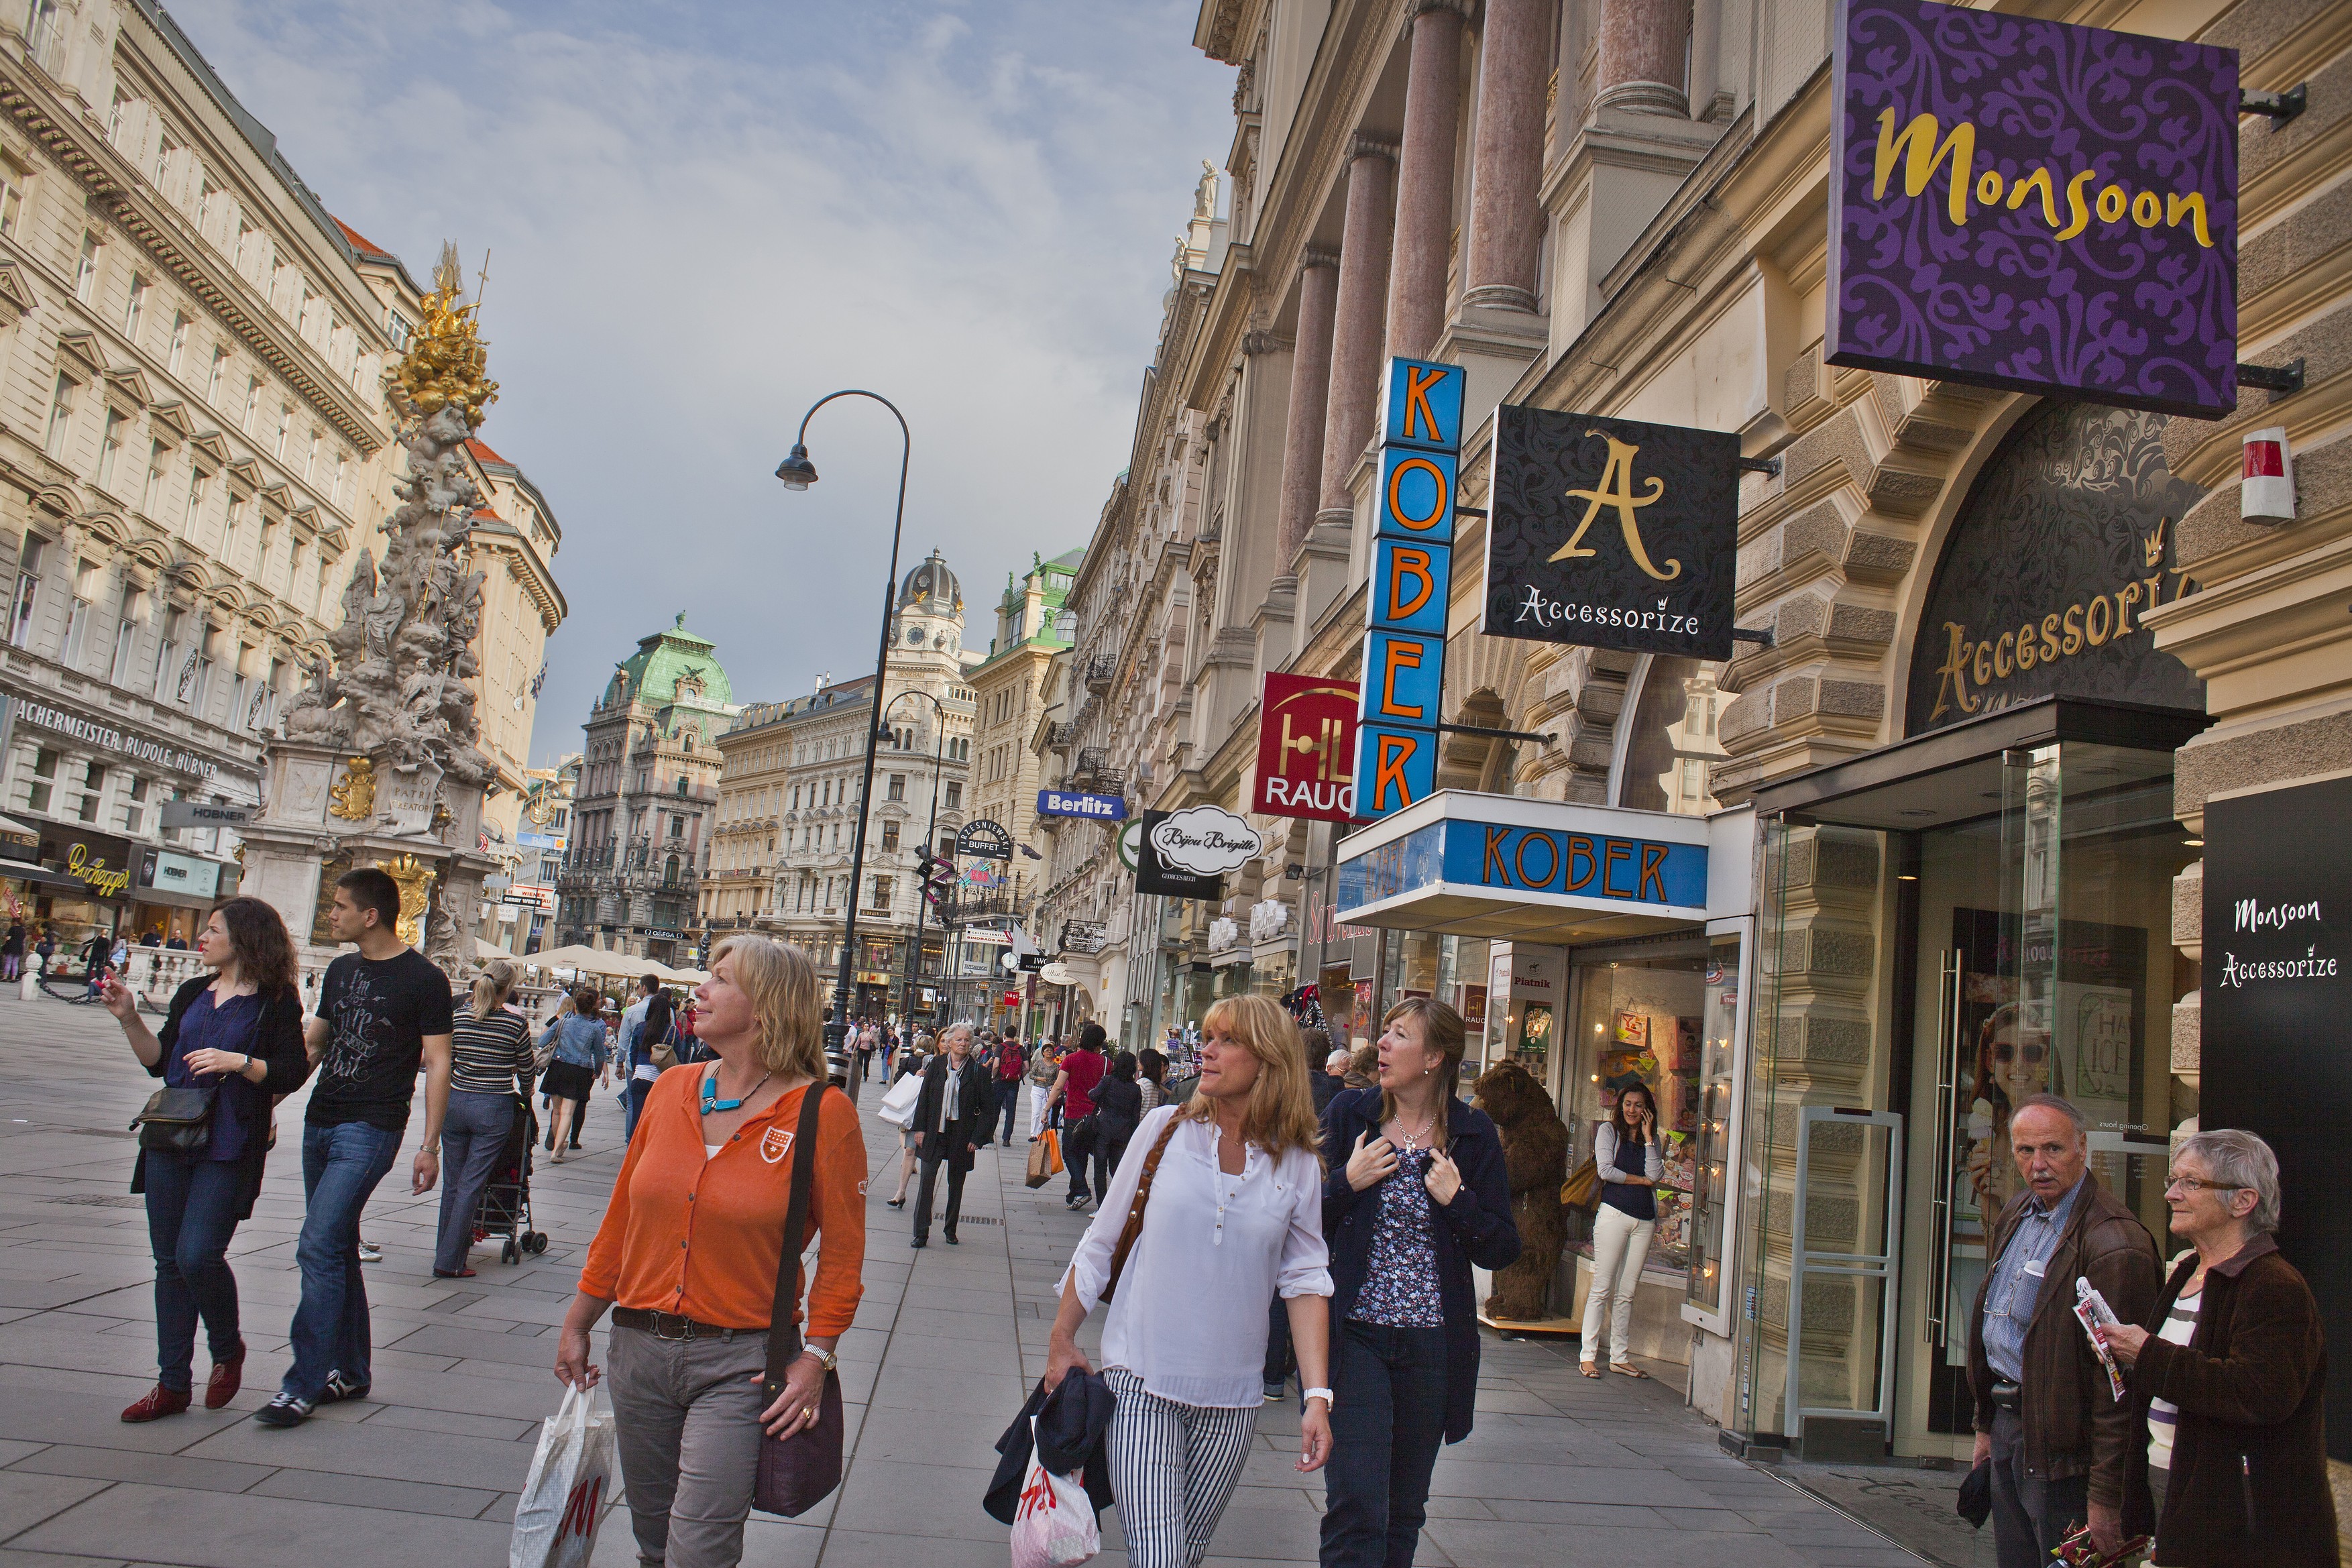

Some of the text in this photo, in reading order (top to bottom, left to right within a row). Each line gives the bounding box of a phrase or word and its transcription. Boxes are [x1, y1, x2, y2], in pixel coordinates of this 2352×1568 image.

[1873, 106, 2215, 248] Monsoon
[1372, 366, 1449, 813] KOBER
[1514, 584, 1699, 636] Accessorize
[176, 752, 218, 780] HÜBNER
[400, 772, 429, 786] DEO
[394, 787, 431, 799] PATRI
[1048, 794, 1113, 815] Berlitz
[193, 807, 246, 822] HÜBNER
[392, 800, 433, 813] CREATORI
[969, 840, 999, 851] BUFFET
[1162, 828, 1255, 852] Bijou Brigitte
[1483, 826, 1670, 902] KOBER
[2235, 899, 2320, 933] Monsoon
[2220, 944, 2337, 988] Accessorize
[1514, 976, 1551, 988] Piatnik
